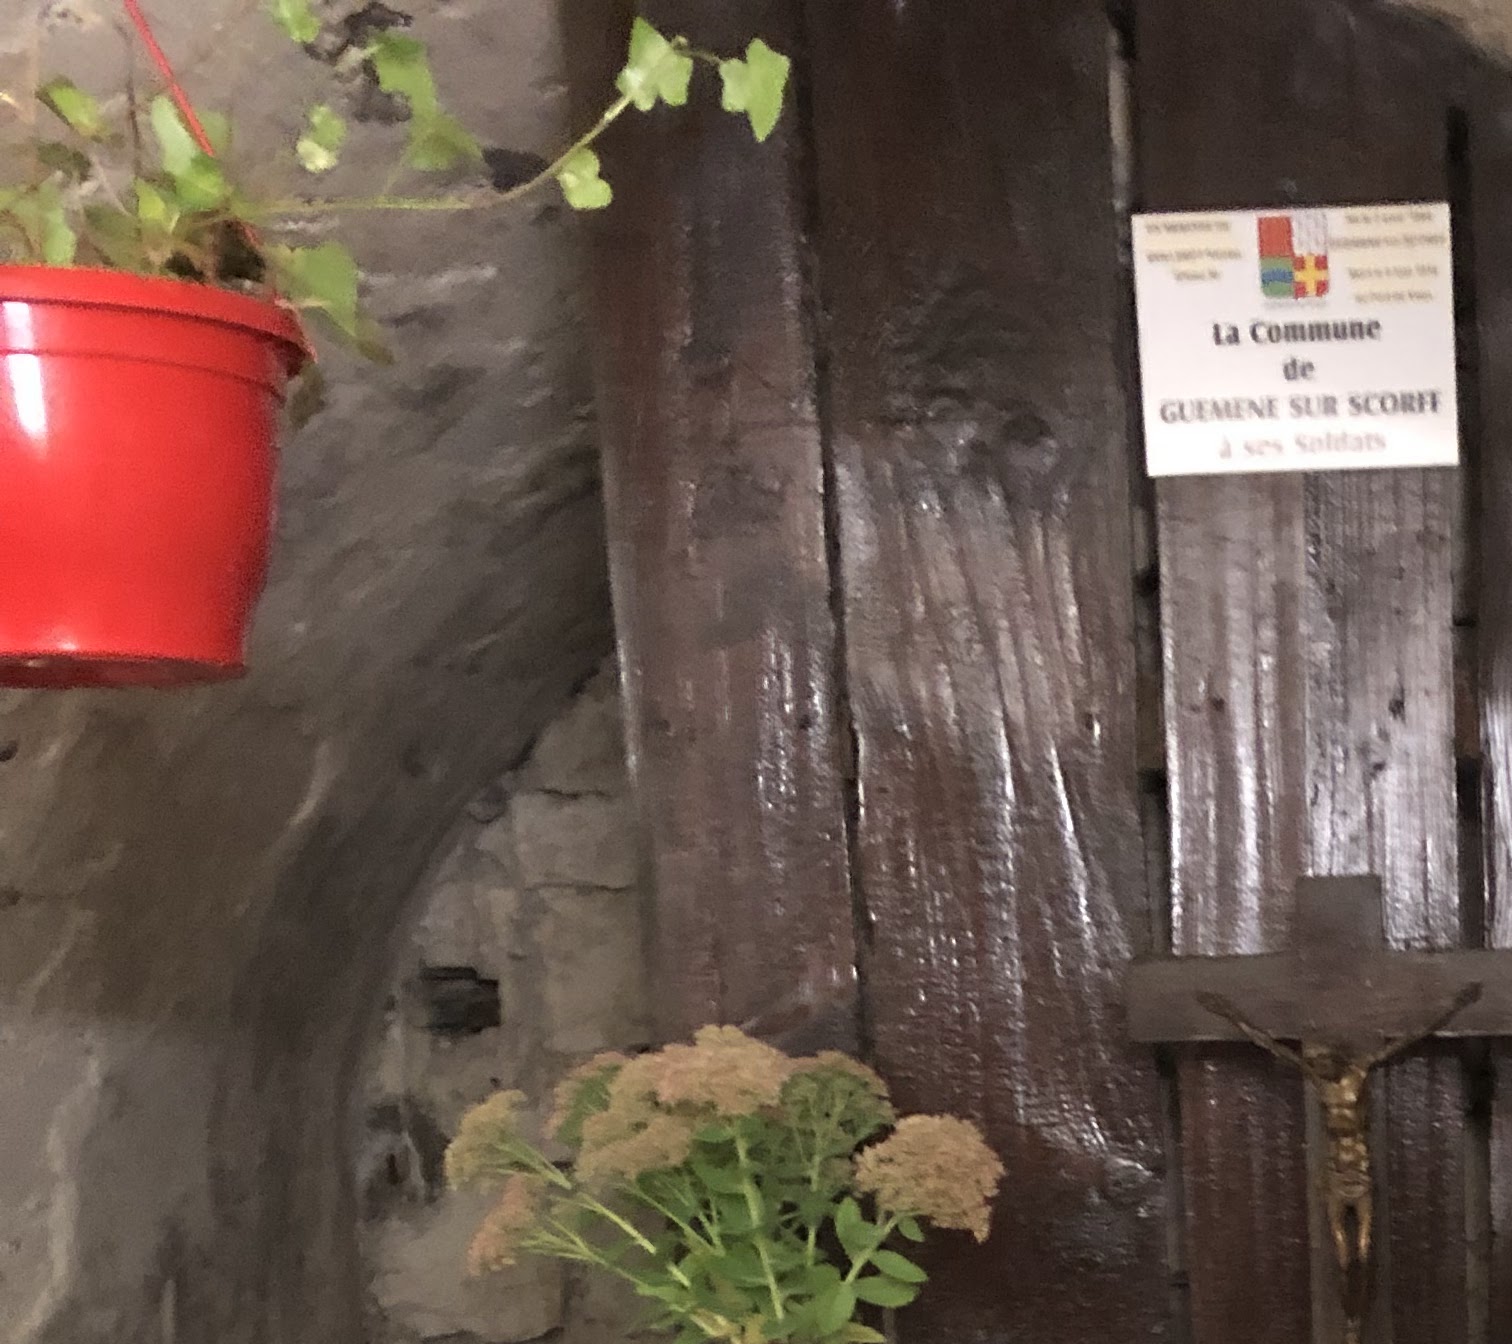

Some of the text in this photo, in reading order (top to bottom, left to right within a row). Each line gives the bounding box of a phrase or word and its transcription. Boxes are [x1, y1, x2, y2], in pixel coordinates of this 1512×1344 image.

[1212, 318, 1381, 346] La Commune
[1282, 355, 1316, 382] de
[1288, 393, 1339, 419] SUR
